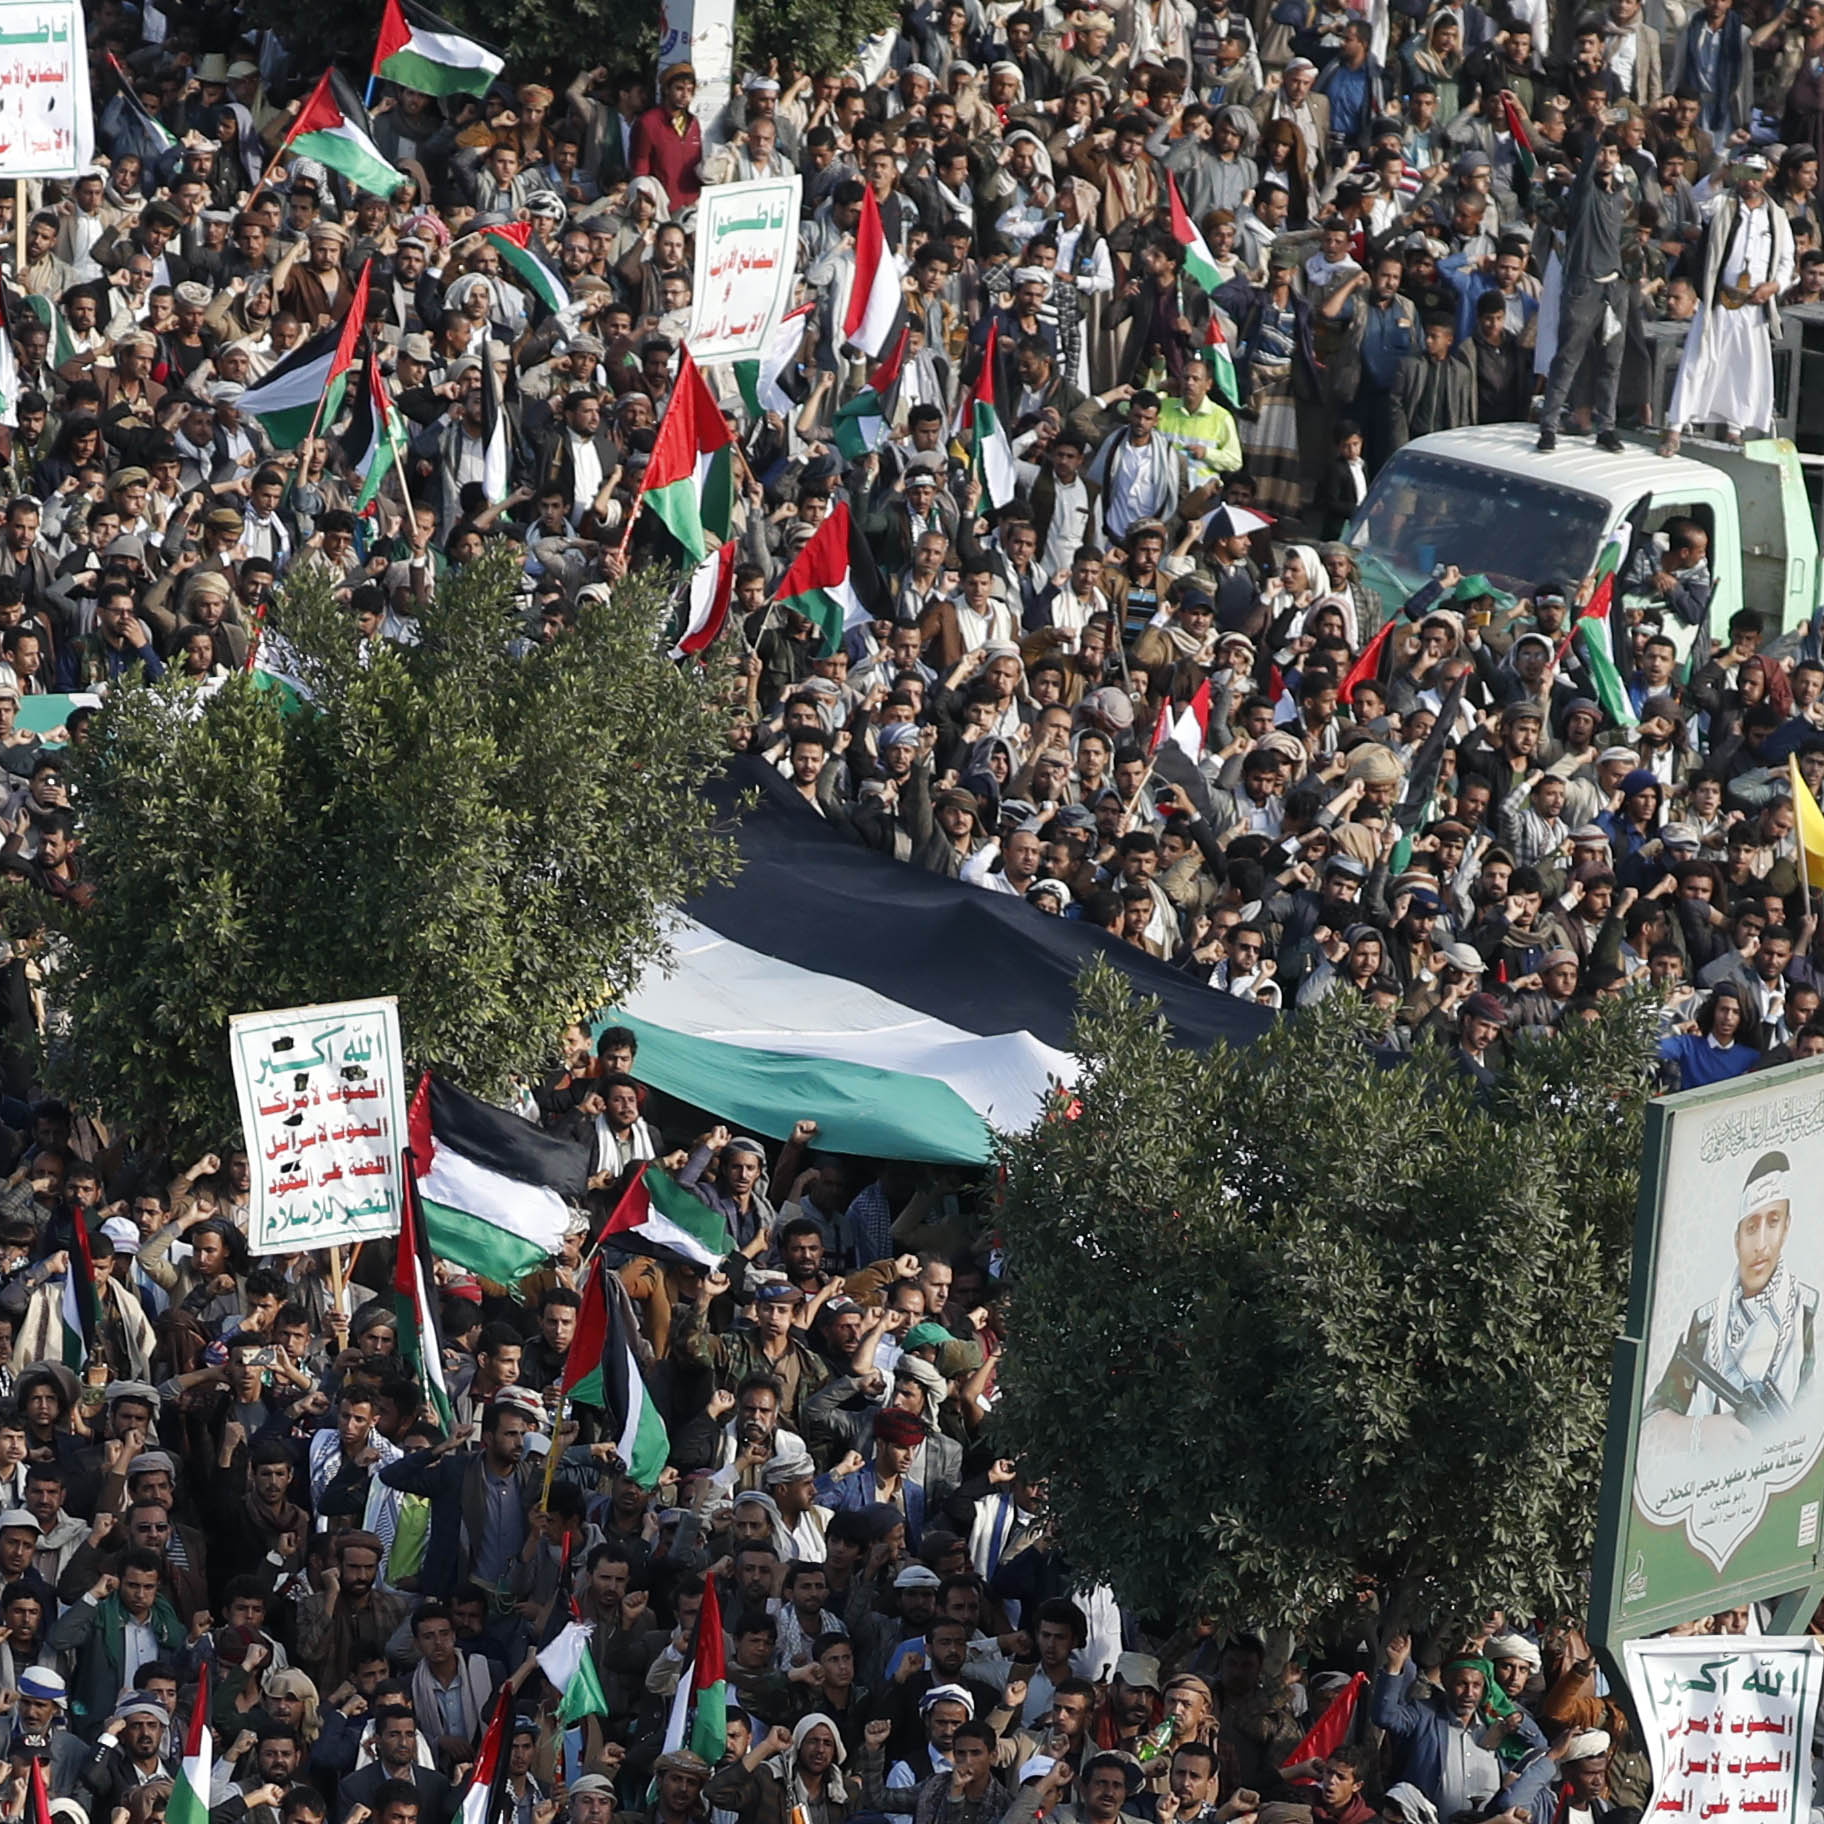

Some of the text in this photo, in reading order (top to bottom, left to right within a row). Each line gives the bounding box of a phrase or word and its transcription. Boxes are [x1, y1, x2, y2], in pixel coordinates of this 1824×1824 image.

[343, 1023, 383, 1063] الله
[326, 1079, 385, 1105] الموت
[330, 1117, 388, 1144] الموت
[339, 1187, 394, 1227] النصر
[1742, 1658, 1800, 1698] الله
[1729, 1713, 1793, 1736] الموت
[1726, 1754, 1791, 1778] الموت
